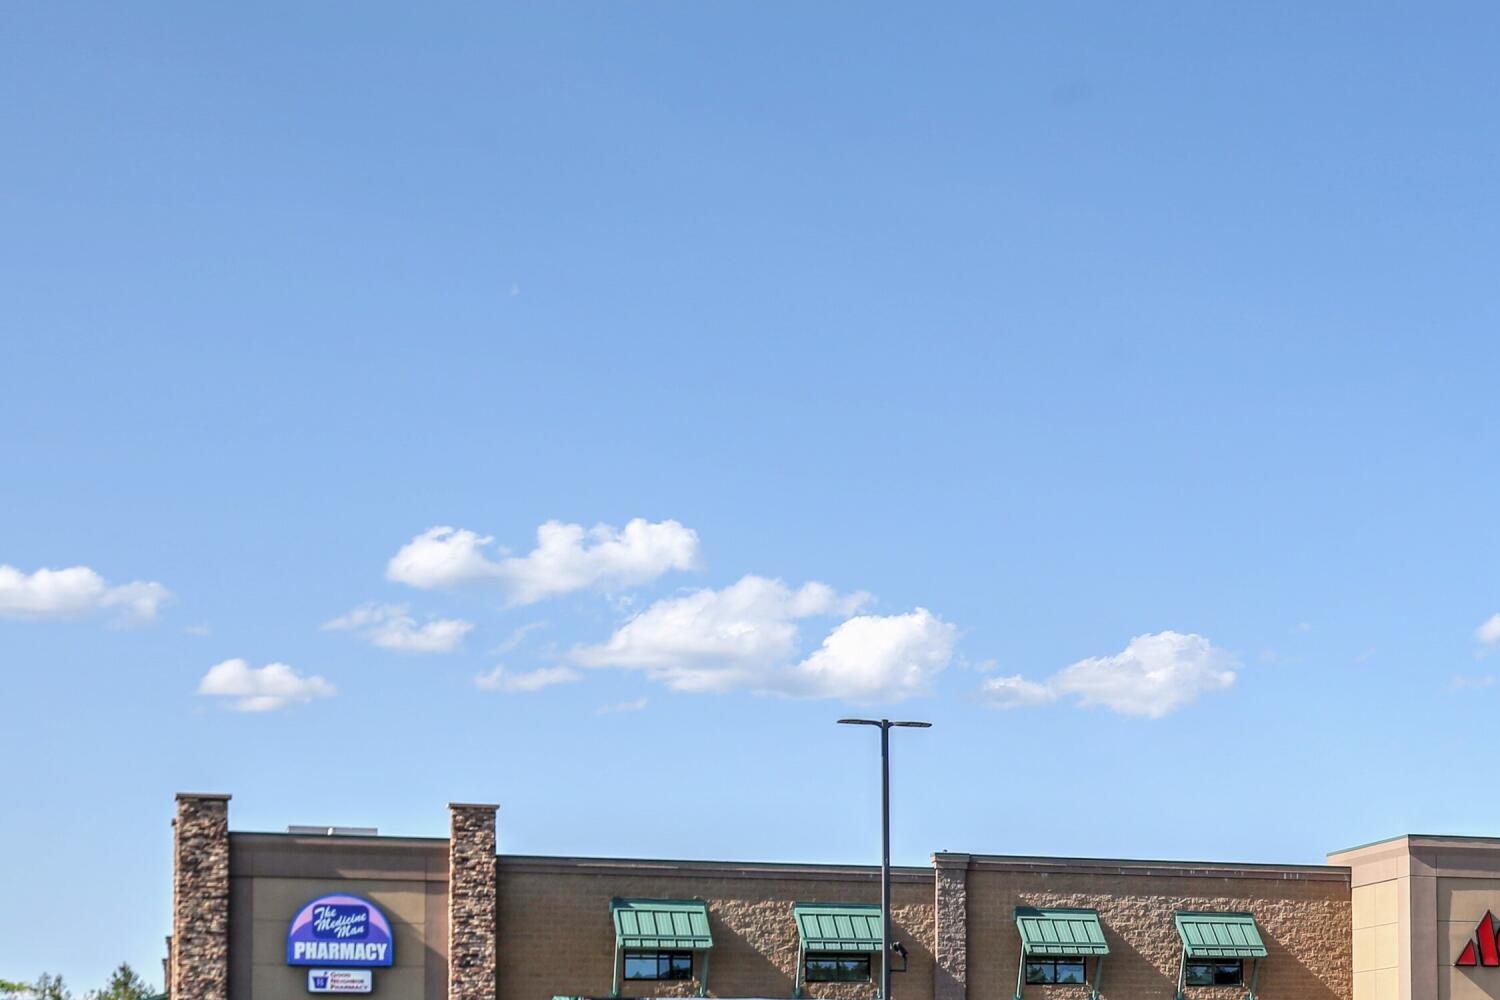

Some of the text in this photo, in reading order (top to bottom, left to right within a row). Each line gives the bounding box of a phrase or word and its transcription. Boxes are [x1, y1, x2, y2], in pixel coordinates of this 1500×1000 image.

[314, 906, 337, 920] The
[314, 913, 367, 932] Medicine
[334, 926, 365, 939] Man
[294, 941, 388, 961] PHARMACY
